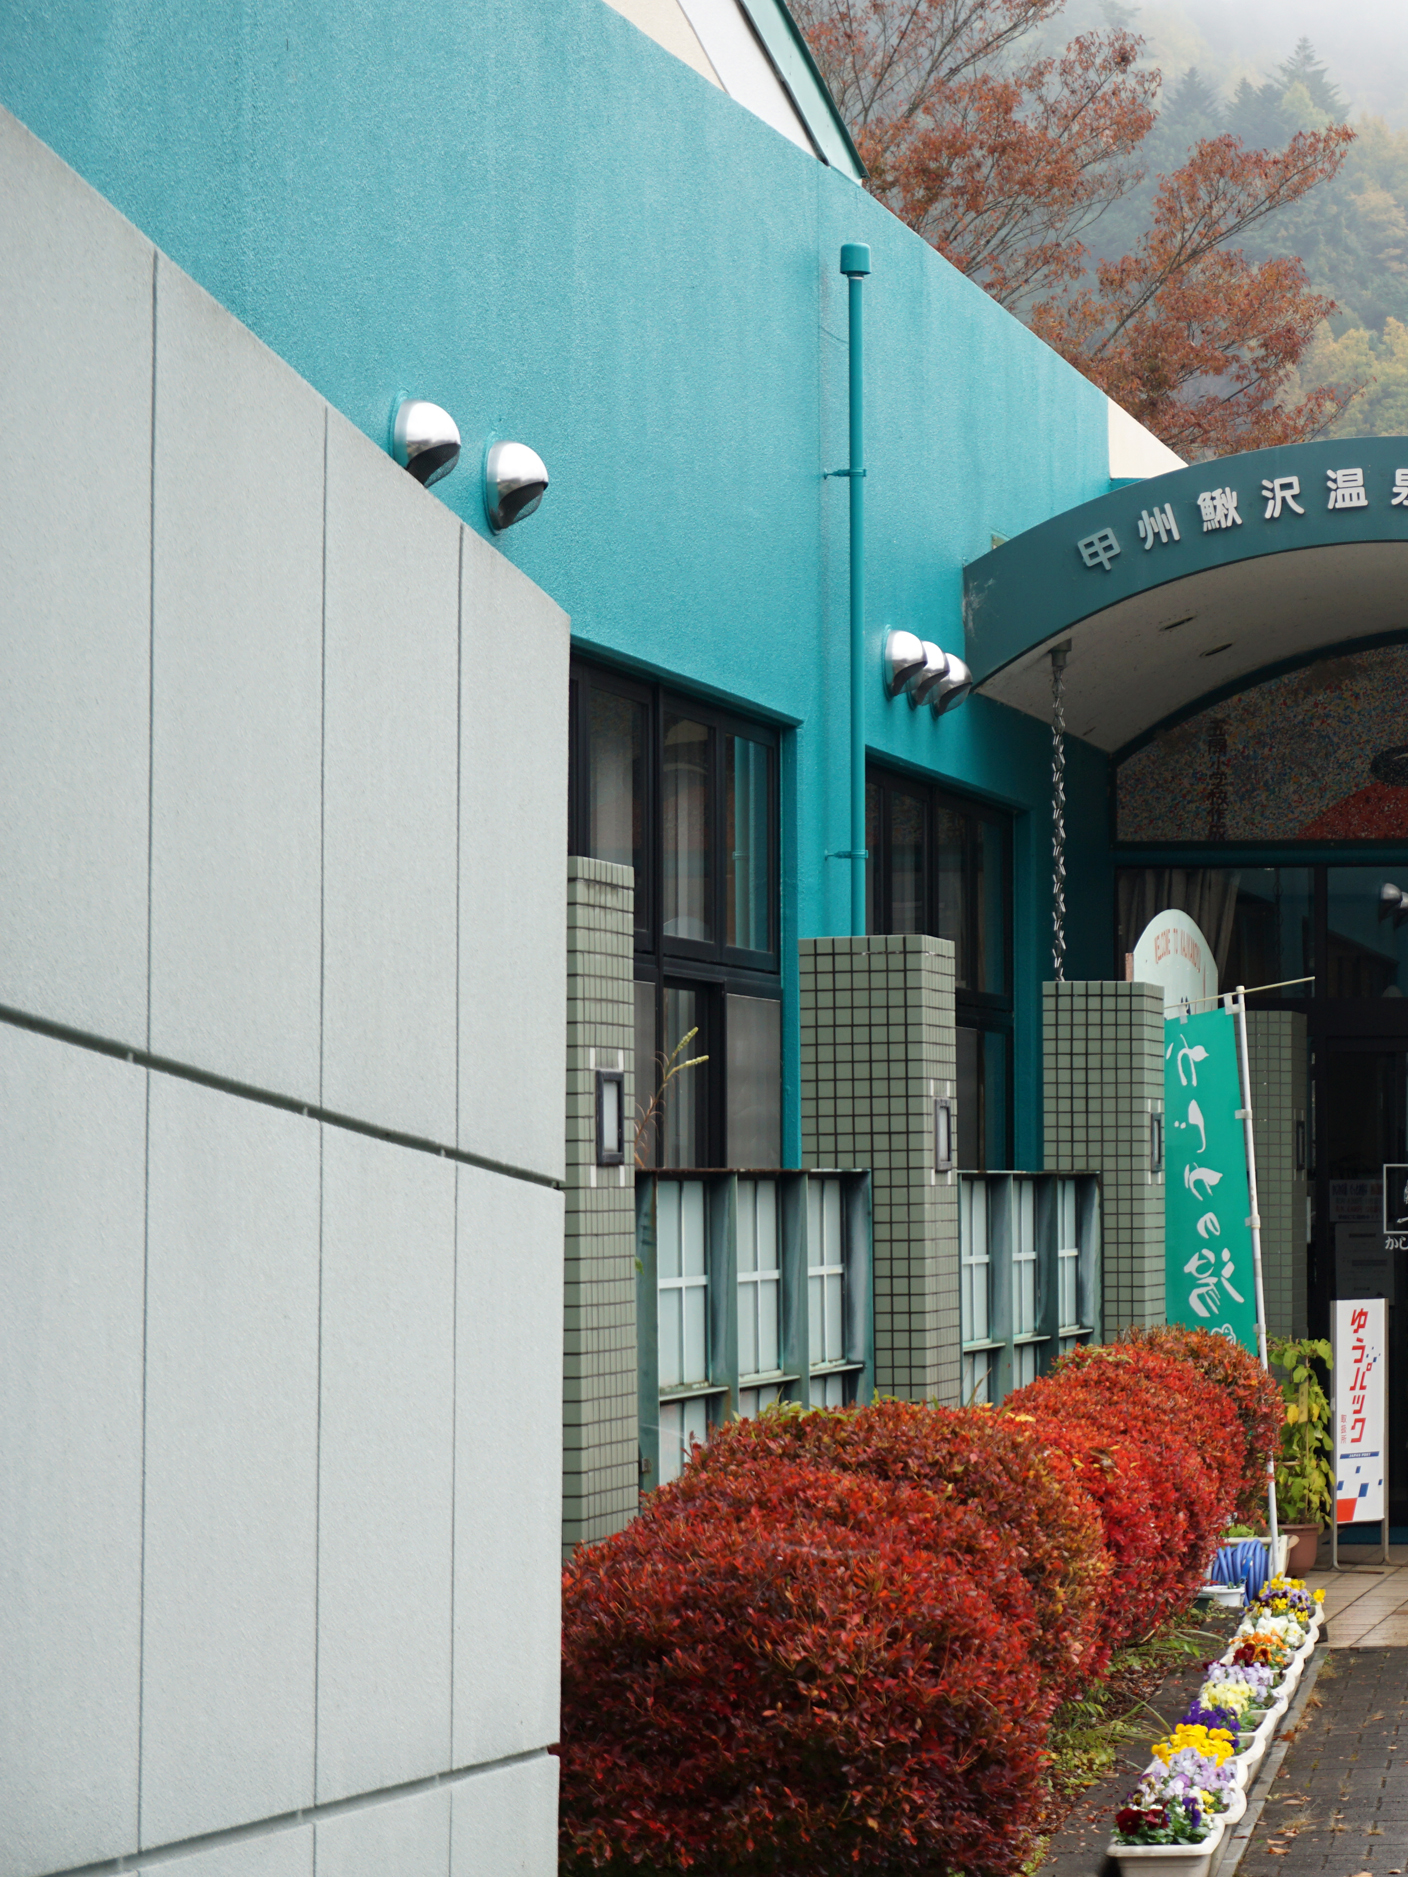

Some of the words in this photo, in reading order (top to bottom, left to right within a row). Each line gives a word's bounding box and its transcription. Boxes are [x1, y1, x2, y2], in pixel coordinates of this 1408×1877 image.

[1349, 1308, 1372, 1443] ゆうパック
